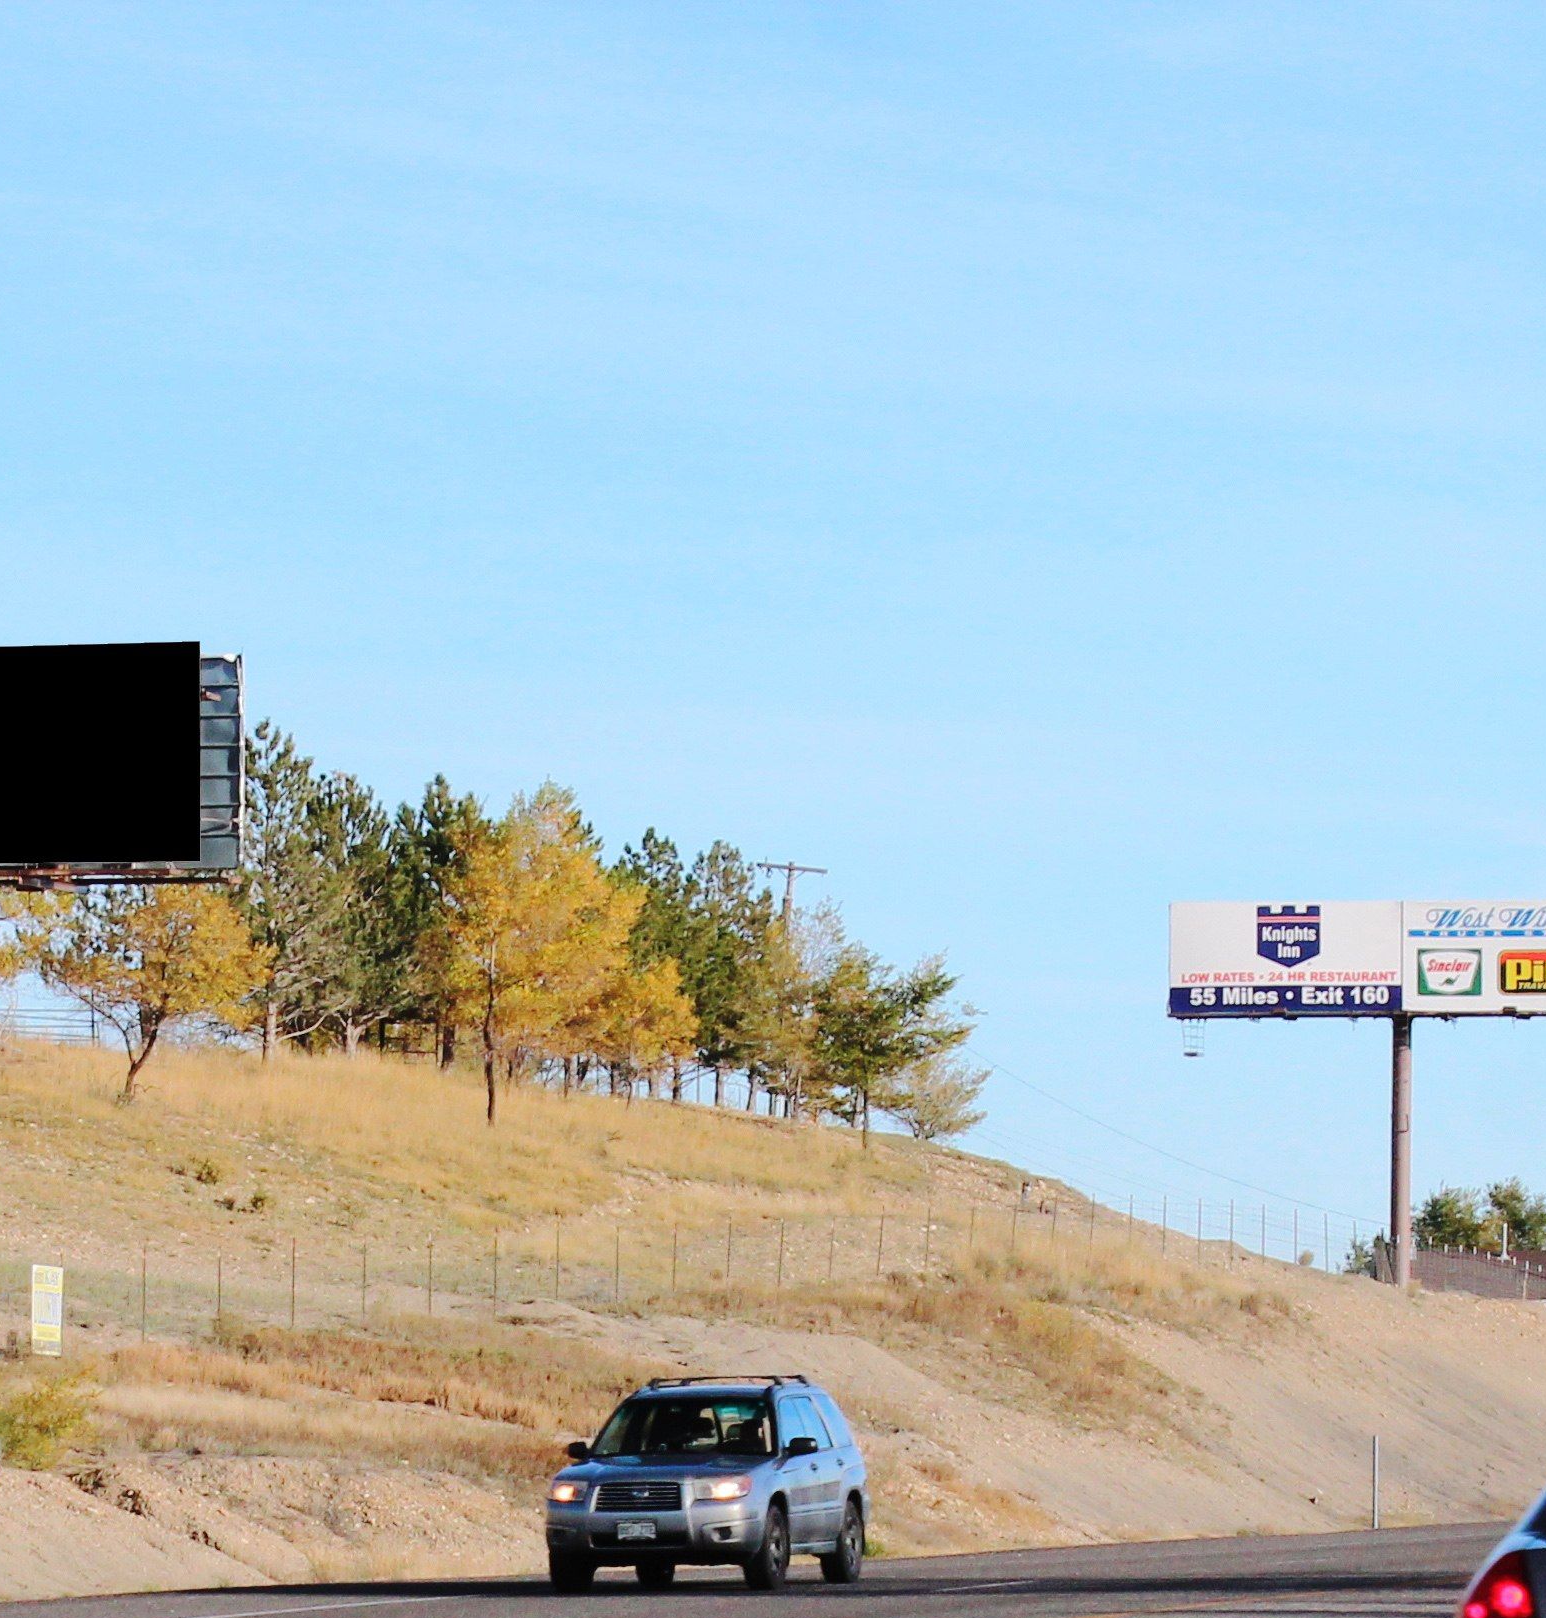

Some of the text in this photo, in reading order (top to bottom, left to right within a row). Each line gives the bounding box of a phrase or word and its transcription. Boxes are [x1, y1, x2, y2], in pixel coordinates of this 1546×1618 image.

[1425, 906, 1495, 929] West
[1261, 925, 1317, 944] Knights
[1277, 942, 1301, 958] Inn
[1427, 957, 1472, 973] Sinclair
[1181, 971, 1397, 983] LOW RATES 24 HR RESTAURANT
[1189, 986, 1390, 1006] 55 Miles Exit 160
